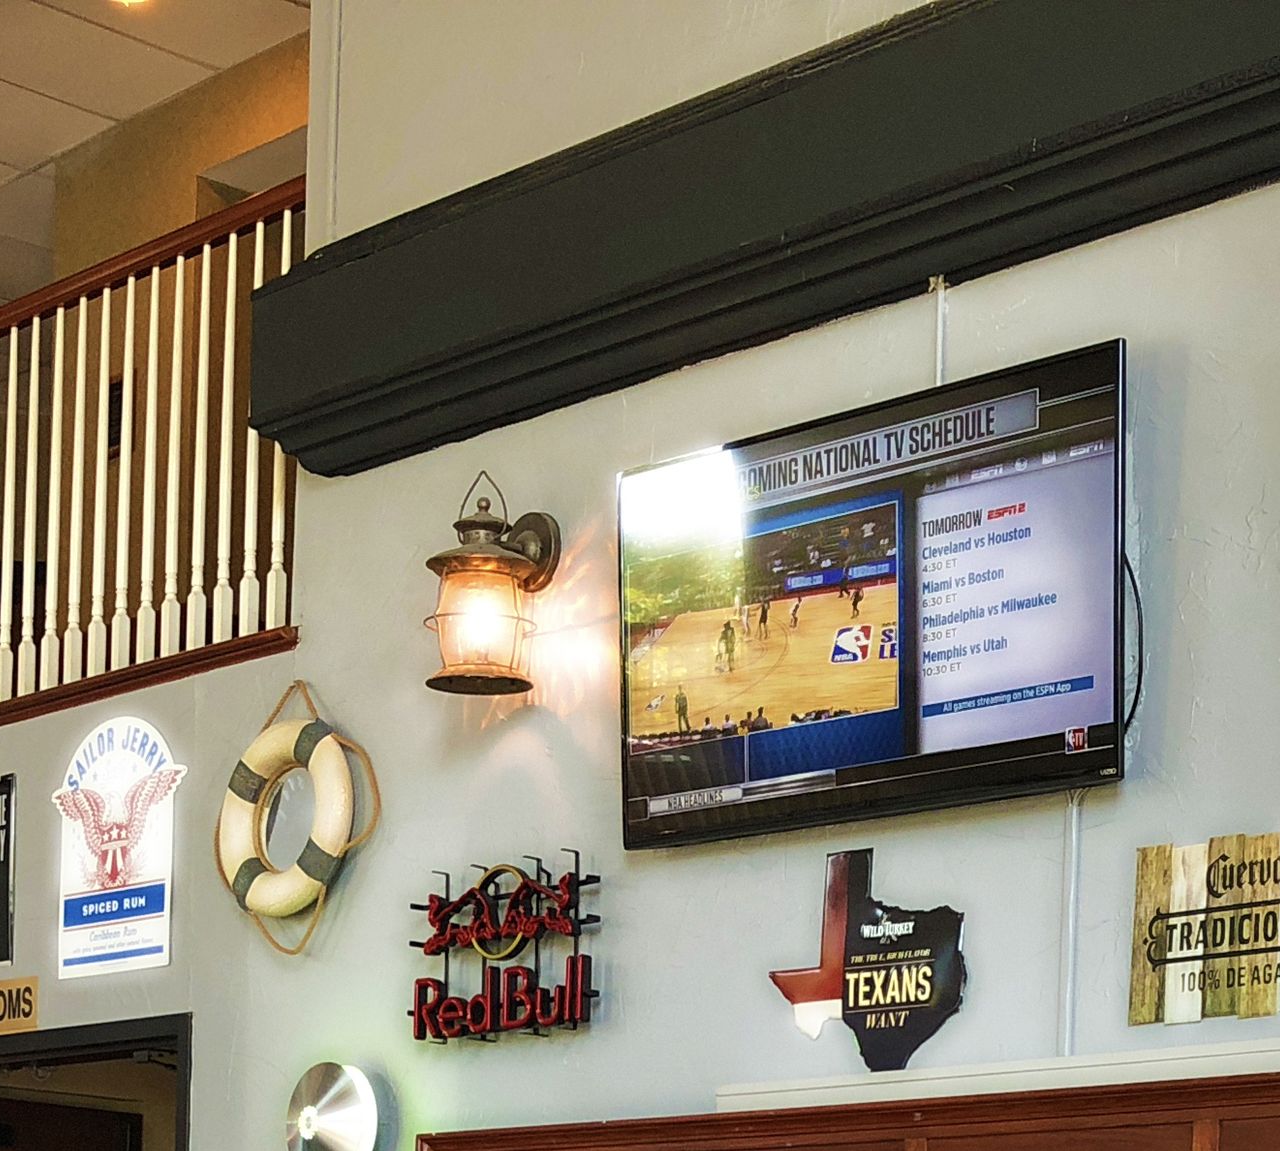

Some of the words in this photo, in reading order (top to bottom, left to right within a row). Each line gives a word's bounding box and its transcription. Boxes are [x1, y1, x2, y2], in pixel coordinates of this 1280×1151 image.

[802, 438, 881, 482] NATIONAL
[884, 429, 906, 461] TV
[908, 406, 996, 454] SCHEDULE
[922, 508, 983, 539] TOMORROW
[922, 537, 972, 560] Cleveland
[974, 536, 986, 549] vs
[987, 526, 1032, 546] Houston
[922, 561, 943, 574] 4:30
[945, 558, 958, 569] ET
[922, 577, 953, 596] Miami
[954, 576, 966, 587] vs
[967, 567, 1005, 586] Boston
[922, 597, 943, 609] 6:30
[945, 593, 958, 604] ET
[922, 606, 985, 630] Philadelphia
[987, 604, 999, 616] vs
[1000, 592, 1058, 614] Milwaukee
[922, 631, 943, 643] 8:30
[945, 628, 958, 639] ET
[922, 643, 968, 665] Memphis
[969, 643, 981, 655] vs
[983, 636, 1008, 652] Utah
[922, 664, 948, 677] 10:30
[949, 661, 962, 672] ET
[942, 701, 953, 711] All
[953, 700, 976, 713] games
[976, 693, 1012, 706] streaming
[1012, 691, 1022, 700] on
[1022, 689, 1034, 698] the
[1035, 685, 1055, 697] ESPN
[1056, 682, 1072, 694] App
[67, 727, 115, 792] SAILOR
[121, 725, 167, 773] JERRY
[82, 900, 119, 917] SPICED
[123, 896, 146, 910] RUM
[860, 923, 885, 938] WILD
[884, 921, 915, 937] TURKEY
[845, 965, 932, 1008] TEXANS
[1180, 969, 1221, 993] 100%
[1226, 965, 1246, 988] DE
[413, 967, 501, 1040] Red
[503, 954, 591, 1030] Bull
[866, 1011, 909, 1029] WANT
